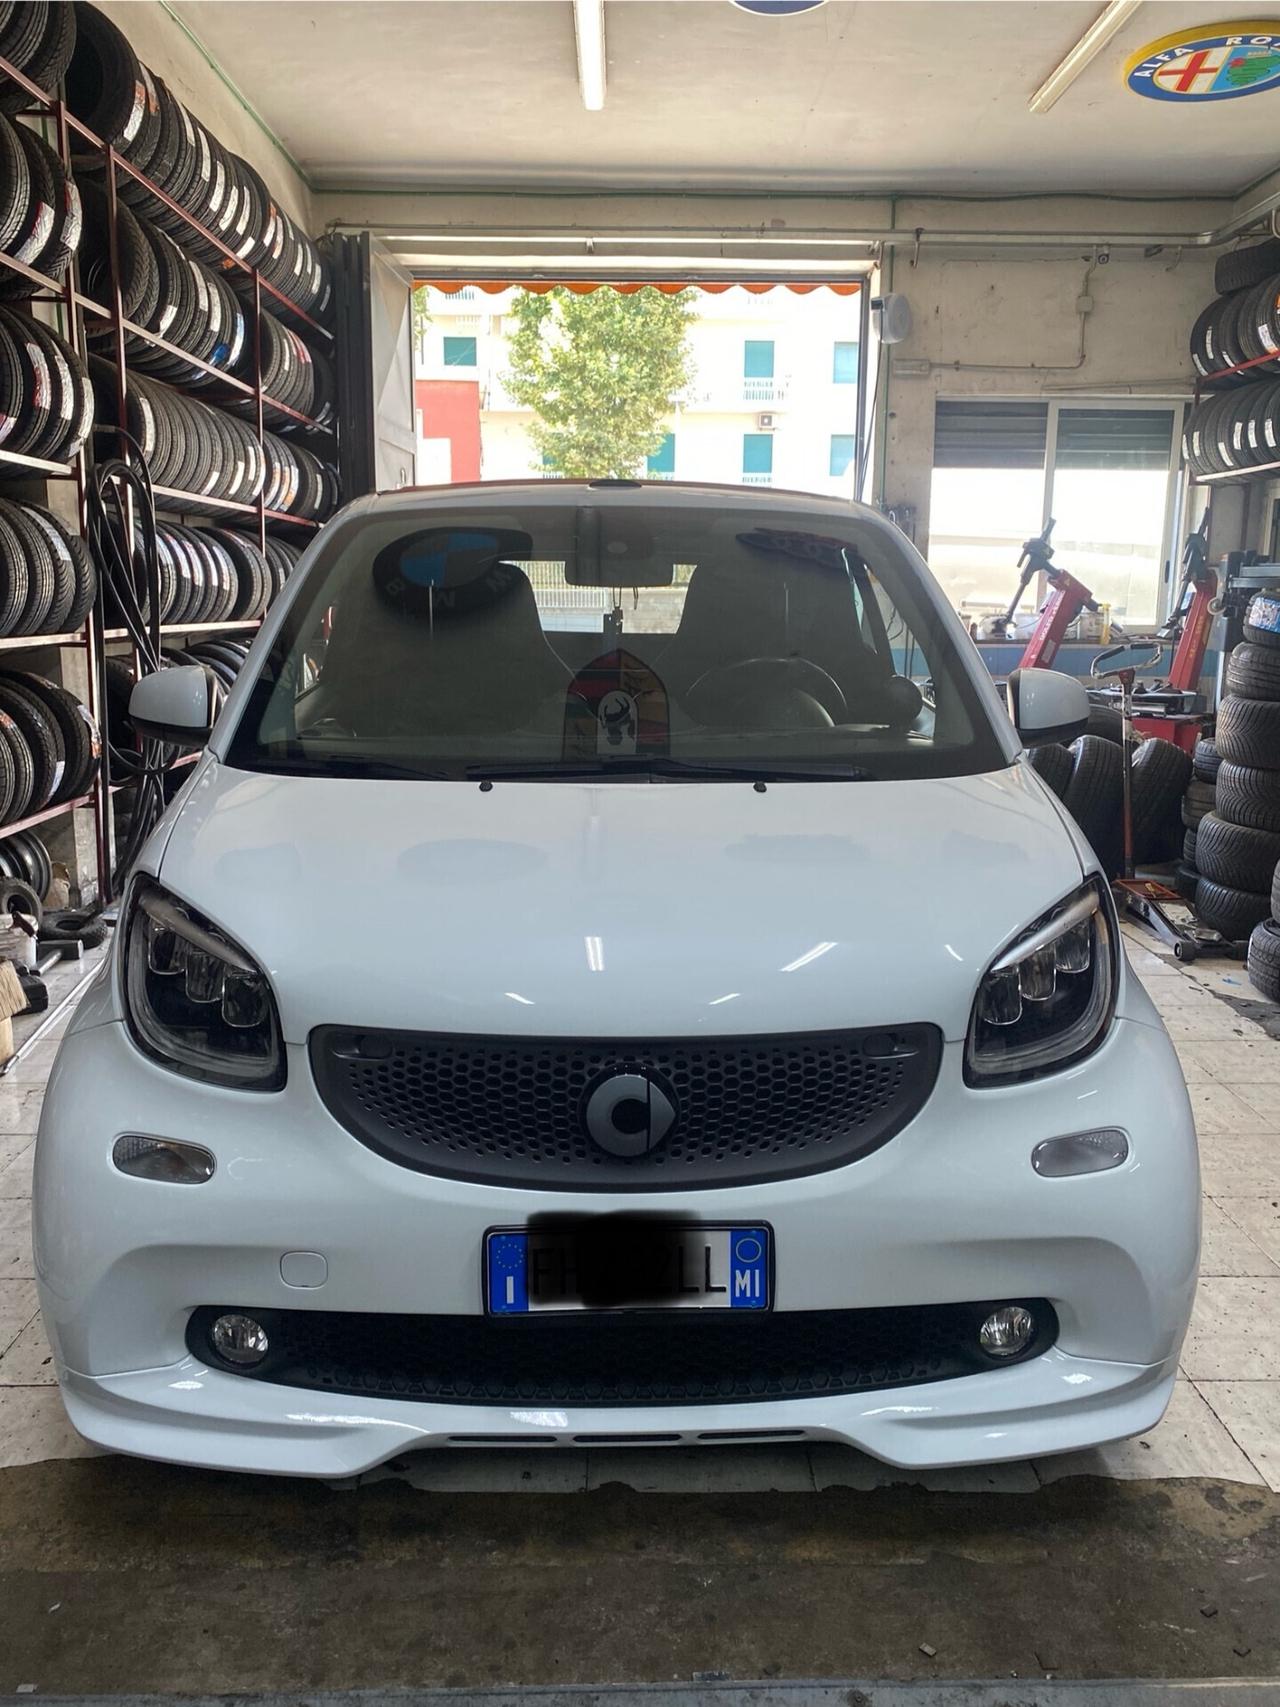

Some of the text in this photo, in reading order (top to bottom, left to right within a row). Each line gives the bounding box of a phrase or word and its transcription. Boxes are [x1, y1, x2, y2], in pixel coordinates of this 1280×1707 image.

[1134, 36, 1280, 77] ALFA RO
[506, 1276, 514, 1304] I
[735, 1269, 760, 1298] MI
